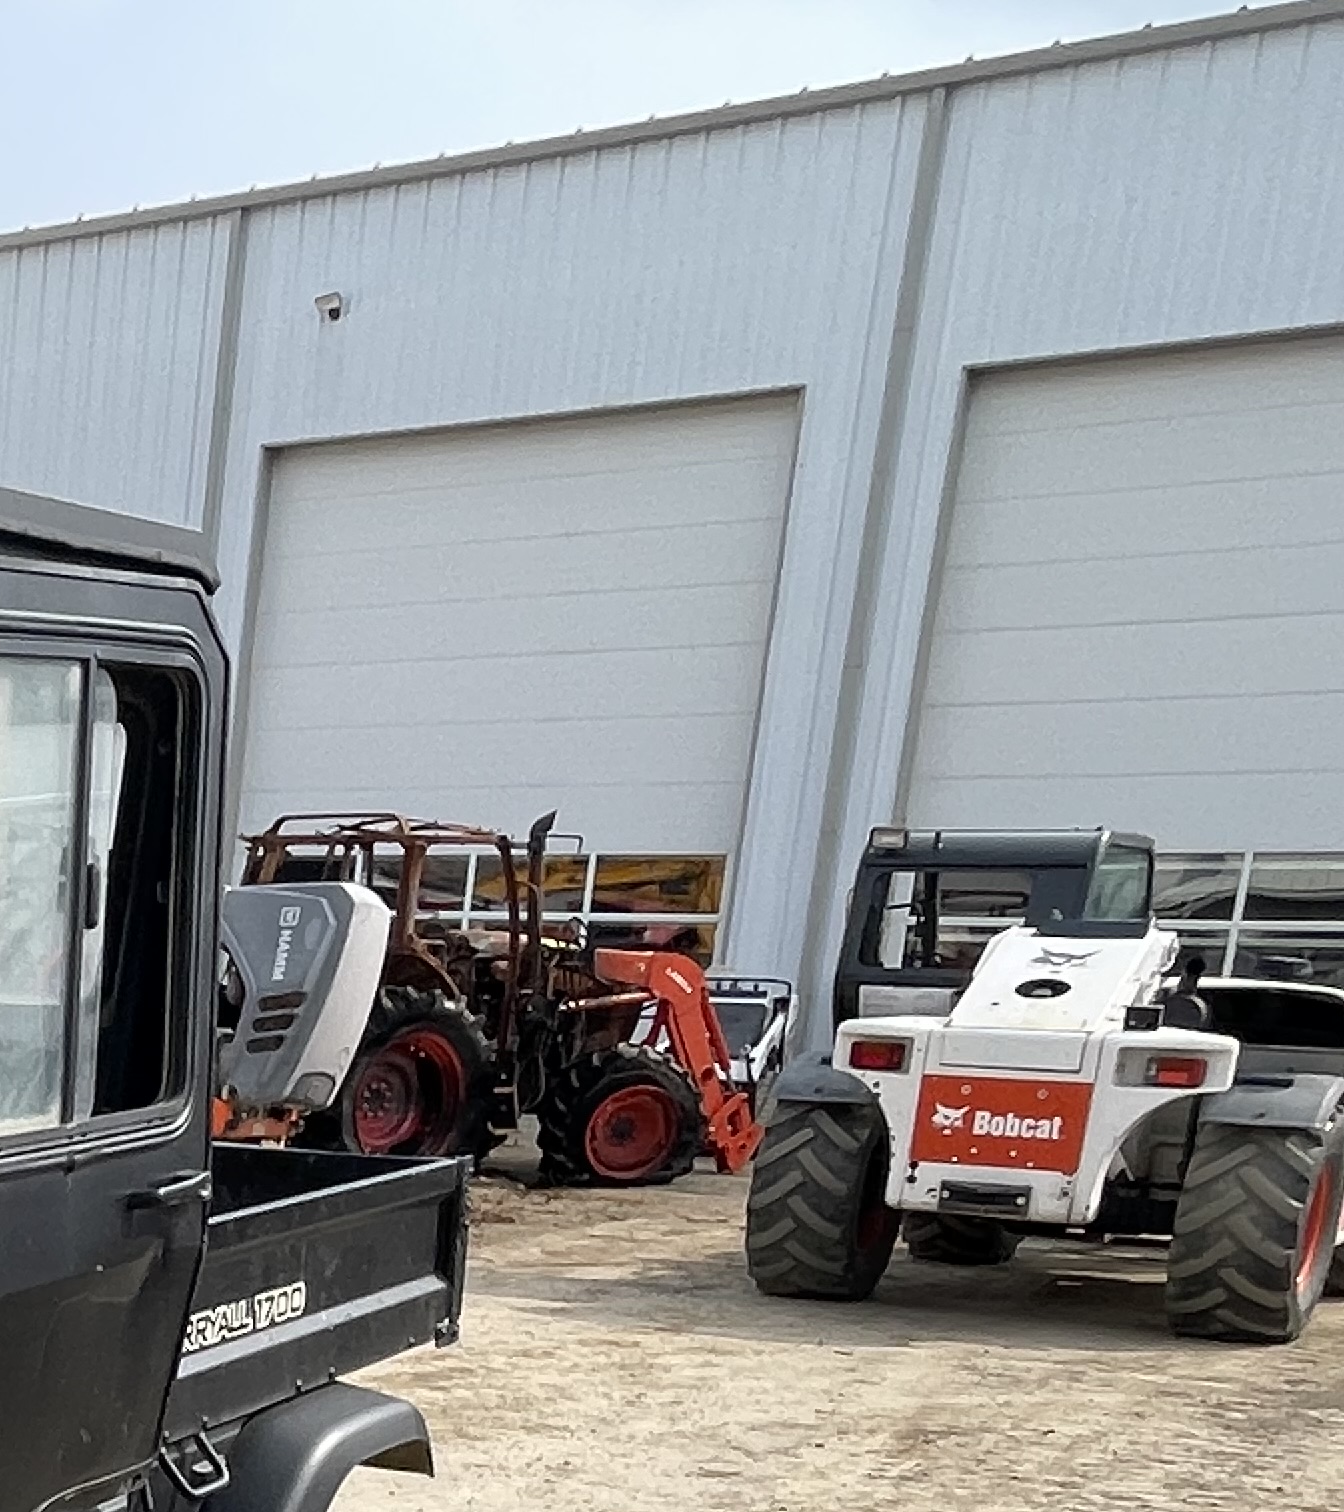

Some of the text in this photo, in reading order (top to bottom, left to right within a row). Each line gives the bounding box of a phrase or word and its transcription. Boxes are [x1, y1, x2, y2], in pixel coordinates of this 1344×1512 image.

[272, 929, 293, 981] HAMM
[973, 1111, 1061, 1139] Bobcat
[254, 1281, 306, 1329] 1700
